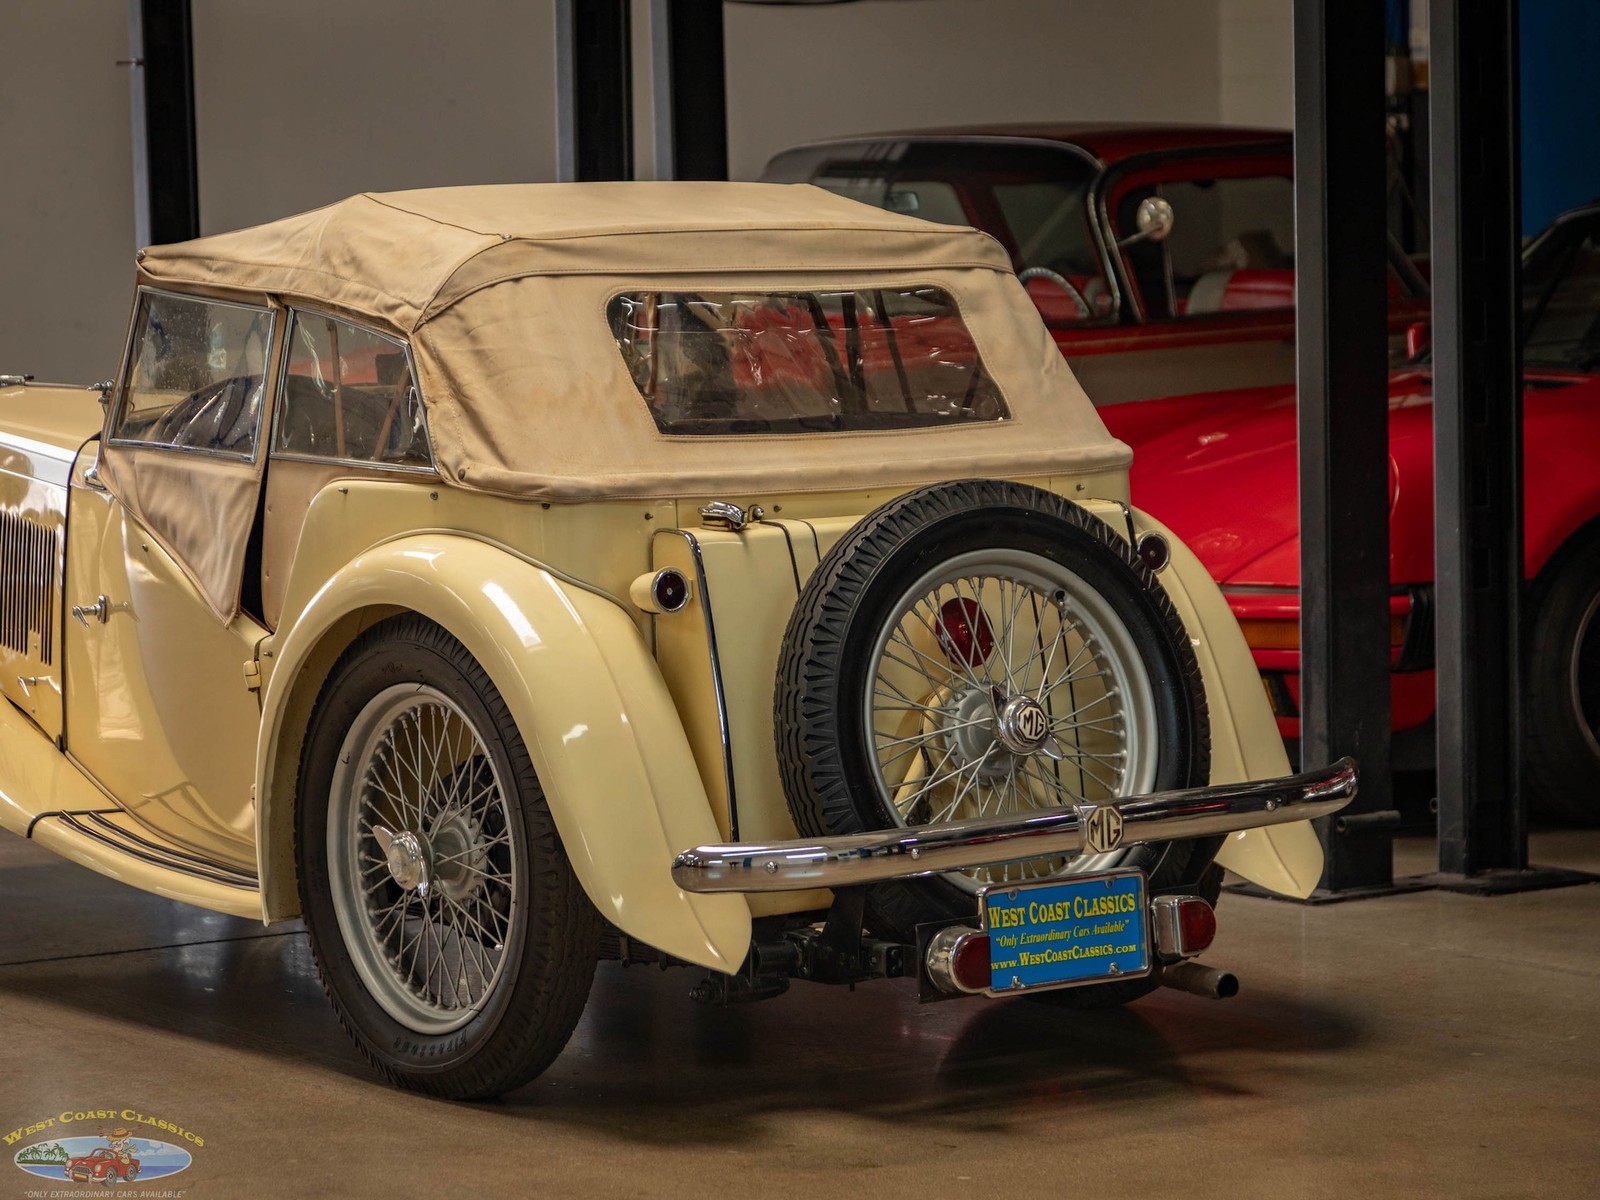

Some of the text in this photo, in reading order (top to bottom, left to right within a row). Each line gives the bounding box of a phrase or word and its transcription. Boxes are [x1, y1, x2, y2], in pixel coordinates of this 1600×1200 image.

[1023, 709, 1045, 737] MG
[1090, 809, 1121, 850] MG
[988, 892, 1136, 929] WEST COAST CLASSICS
[1020, 929, 1071, 945] Extraordinary
[1073, 926, 1090, 938] Cars
